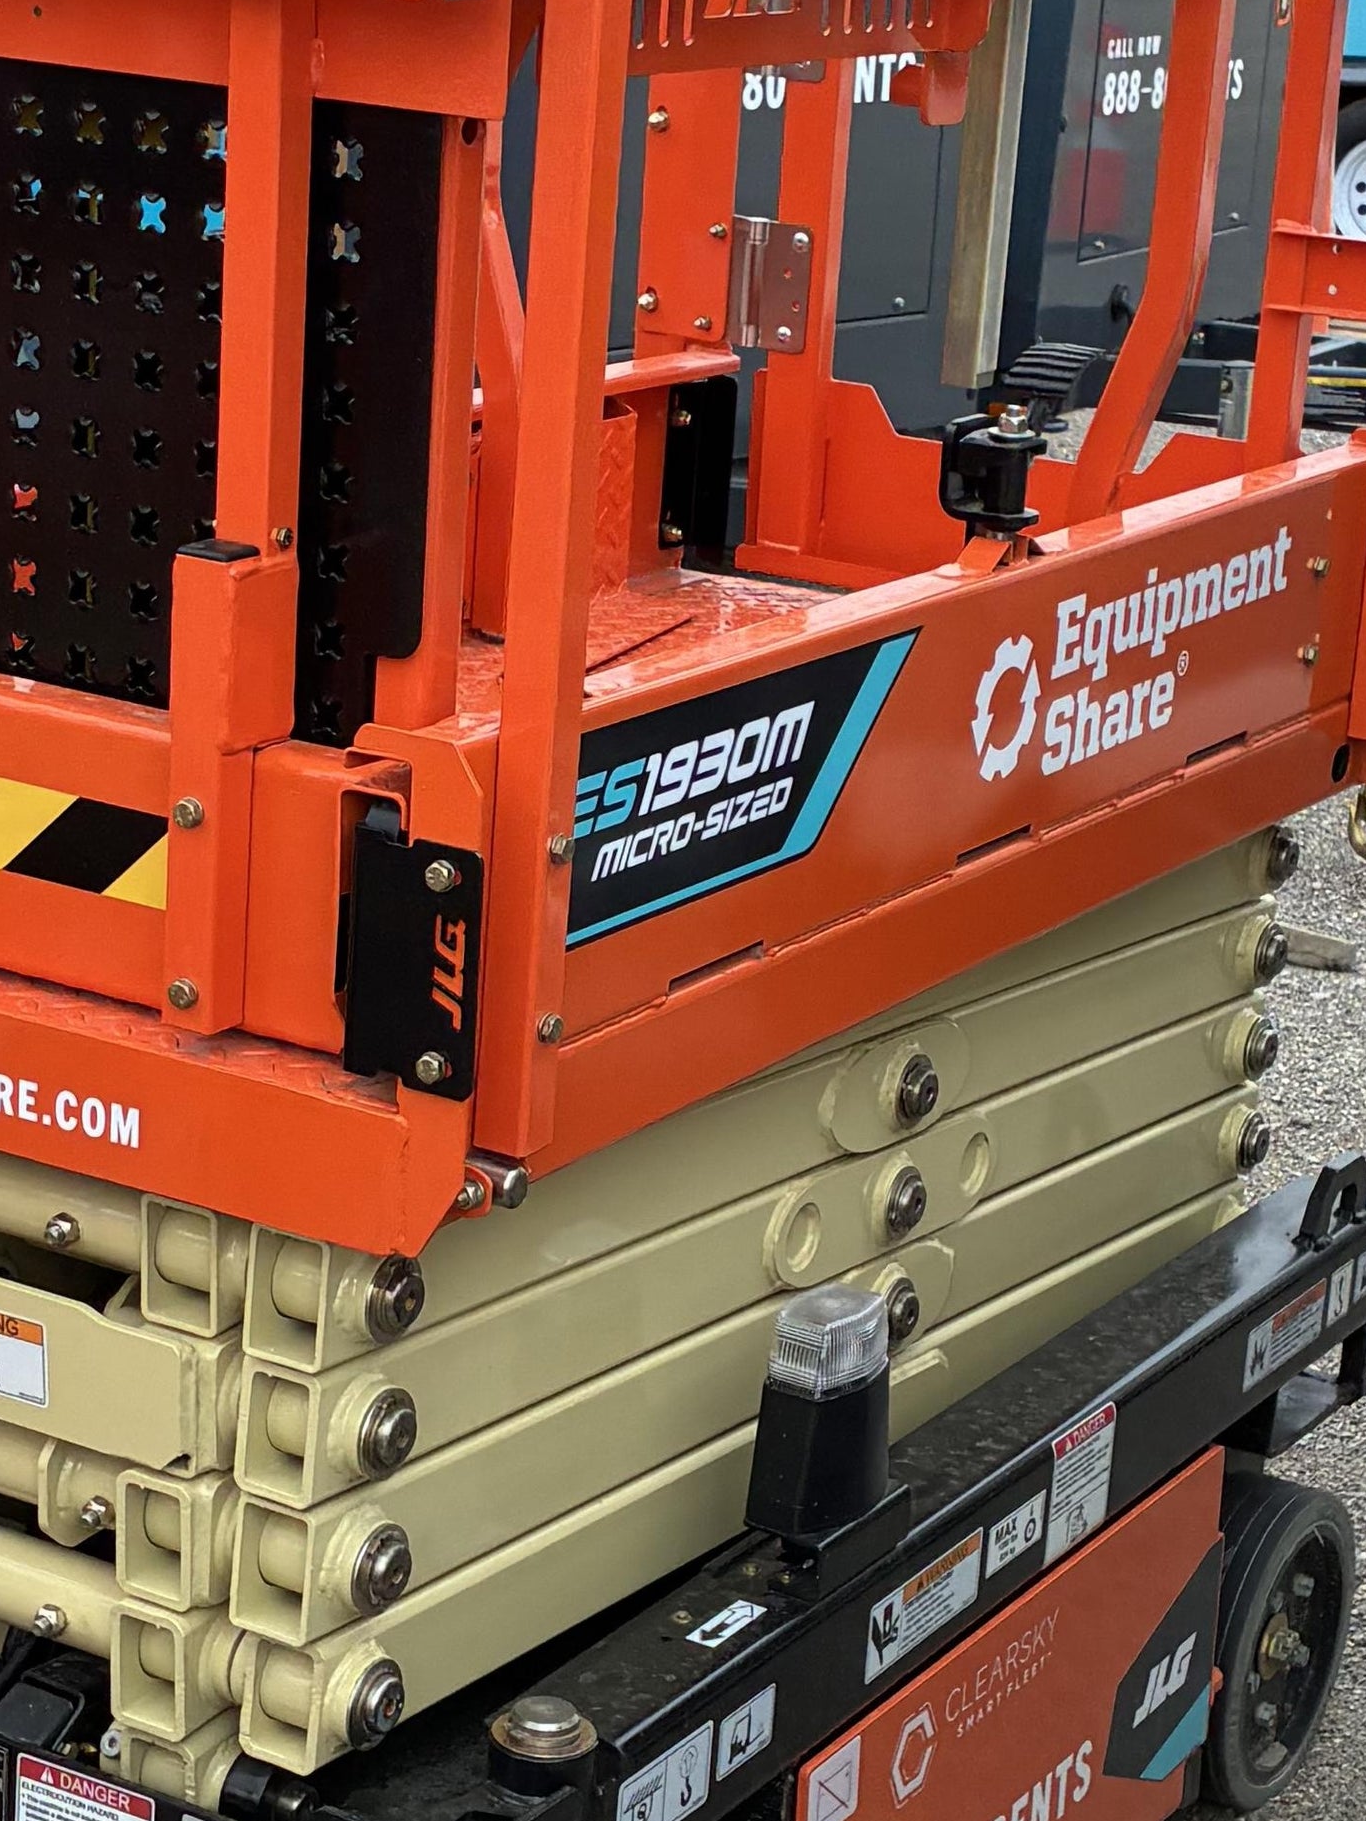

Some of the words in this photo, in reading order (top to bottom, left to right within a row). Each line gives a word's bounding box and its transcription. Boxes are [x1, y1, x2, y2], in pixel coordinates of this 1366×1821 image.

[1107, 38, 1134, 59] CALL
[1137, 35, 1162, 56] NOW
[1050, 526, 1292, 681] Equipment
[573, 700, 815, 839] ES1930M
[590, 777, 793, 882] MICRO-SIZED
[432, 913, 466, 1033] JLG
[945, 1607, 1059, 1722] CLEARSKY
[956, 1692, 1002, 1738] SMART
[1132, 1631, 1197, 1729] JLG
[60, 1773, 130, 1811] DANGER
